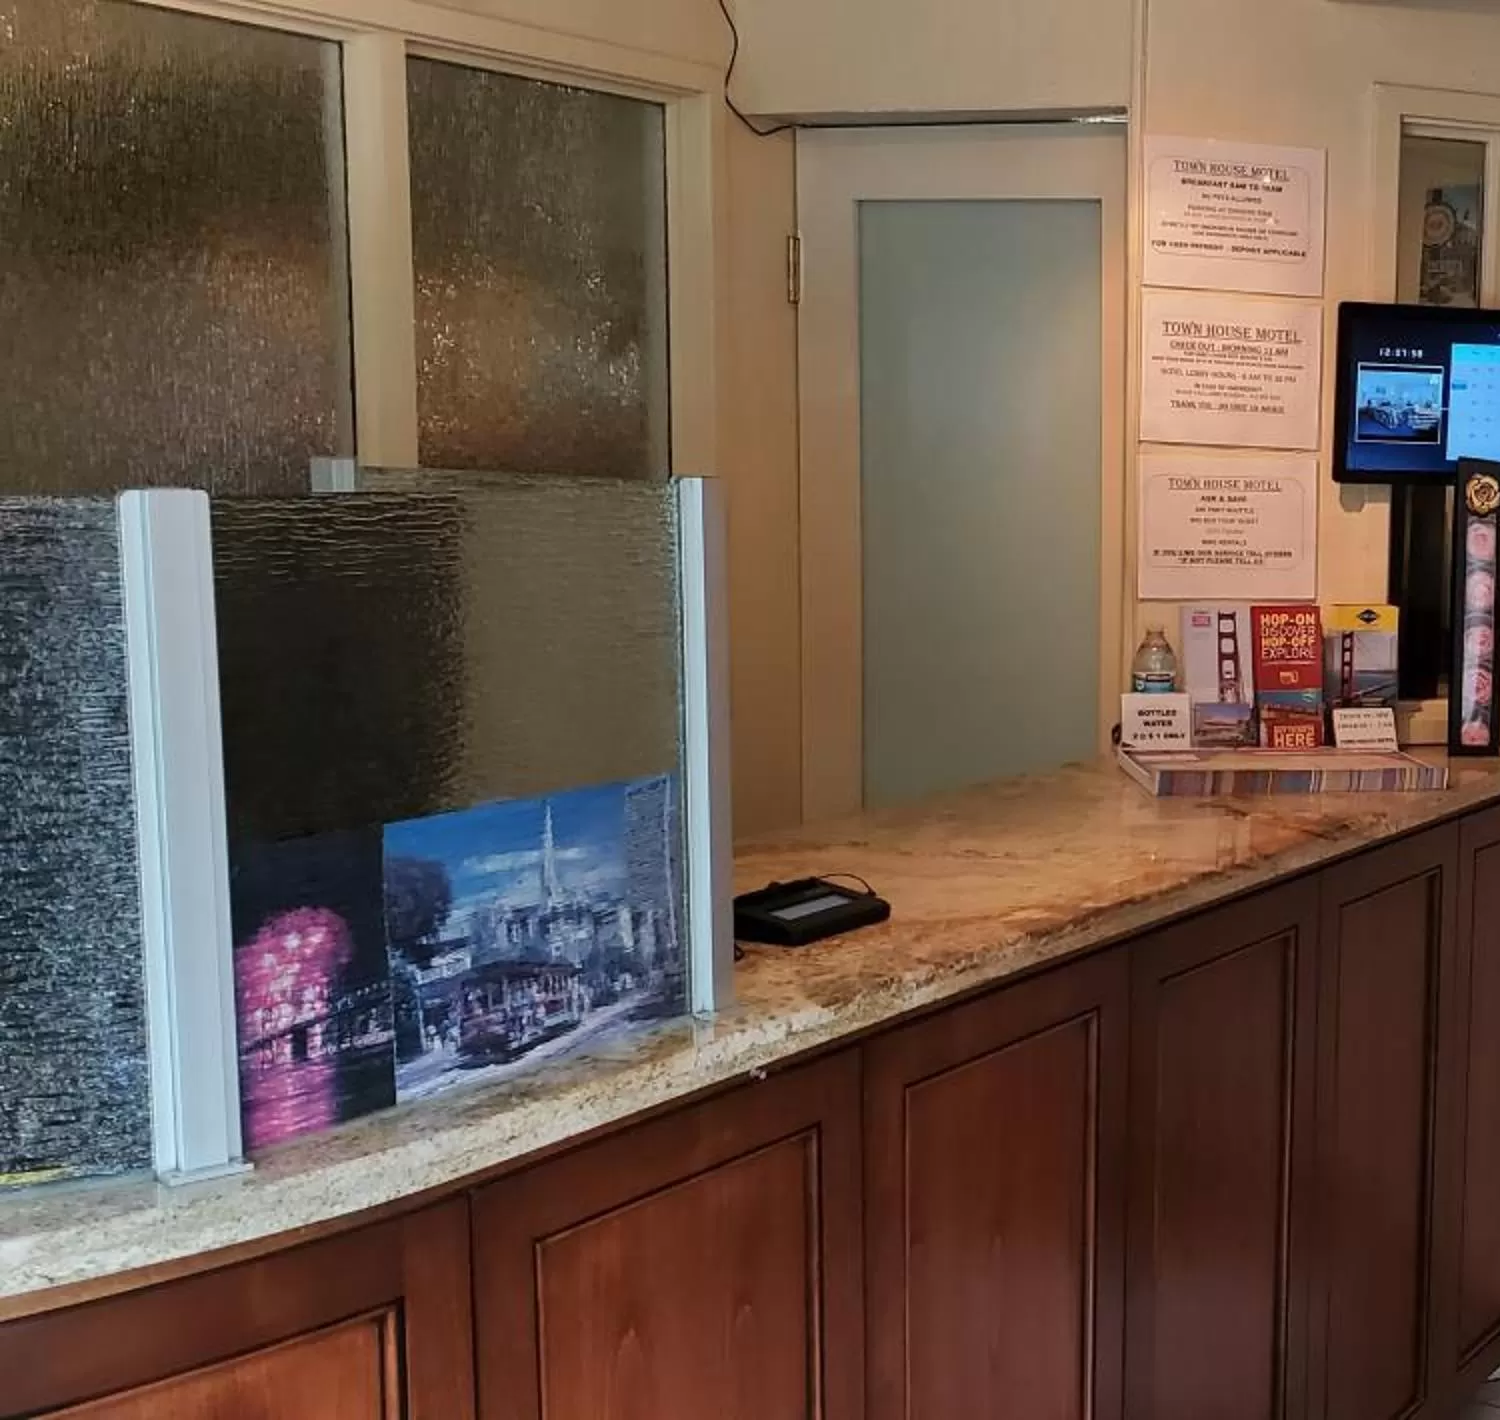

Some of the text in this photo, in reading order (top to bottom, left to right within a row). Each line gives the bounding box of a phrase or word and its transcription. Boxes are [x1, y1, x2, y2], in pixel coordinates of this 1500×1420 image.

[1162, 321, 1301, 343] TOWN HOUSE MOTEL
[1168, 478, 1282, 492] TOWN HOUSE MOTEL
[1260, 612, 1316, 626] HOP-ON
[1261, 625, 1316, 638] DISCOVER
[1261, 635, 1316, 648] HOP-OFF
[1261, 647, 1316, 660] EXPLORE
[1142, 719, 1173, 727] WATER
[1274, 733, 1317, 748] HERE
